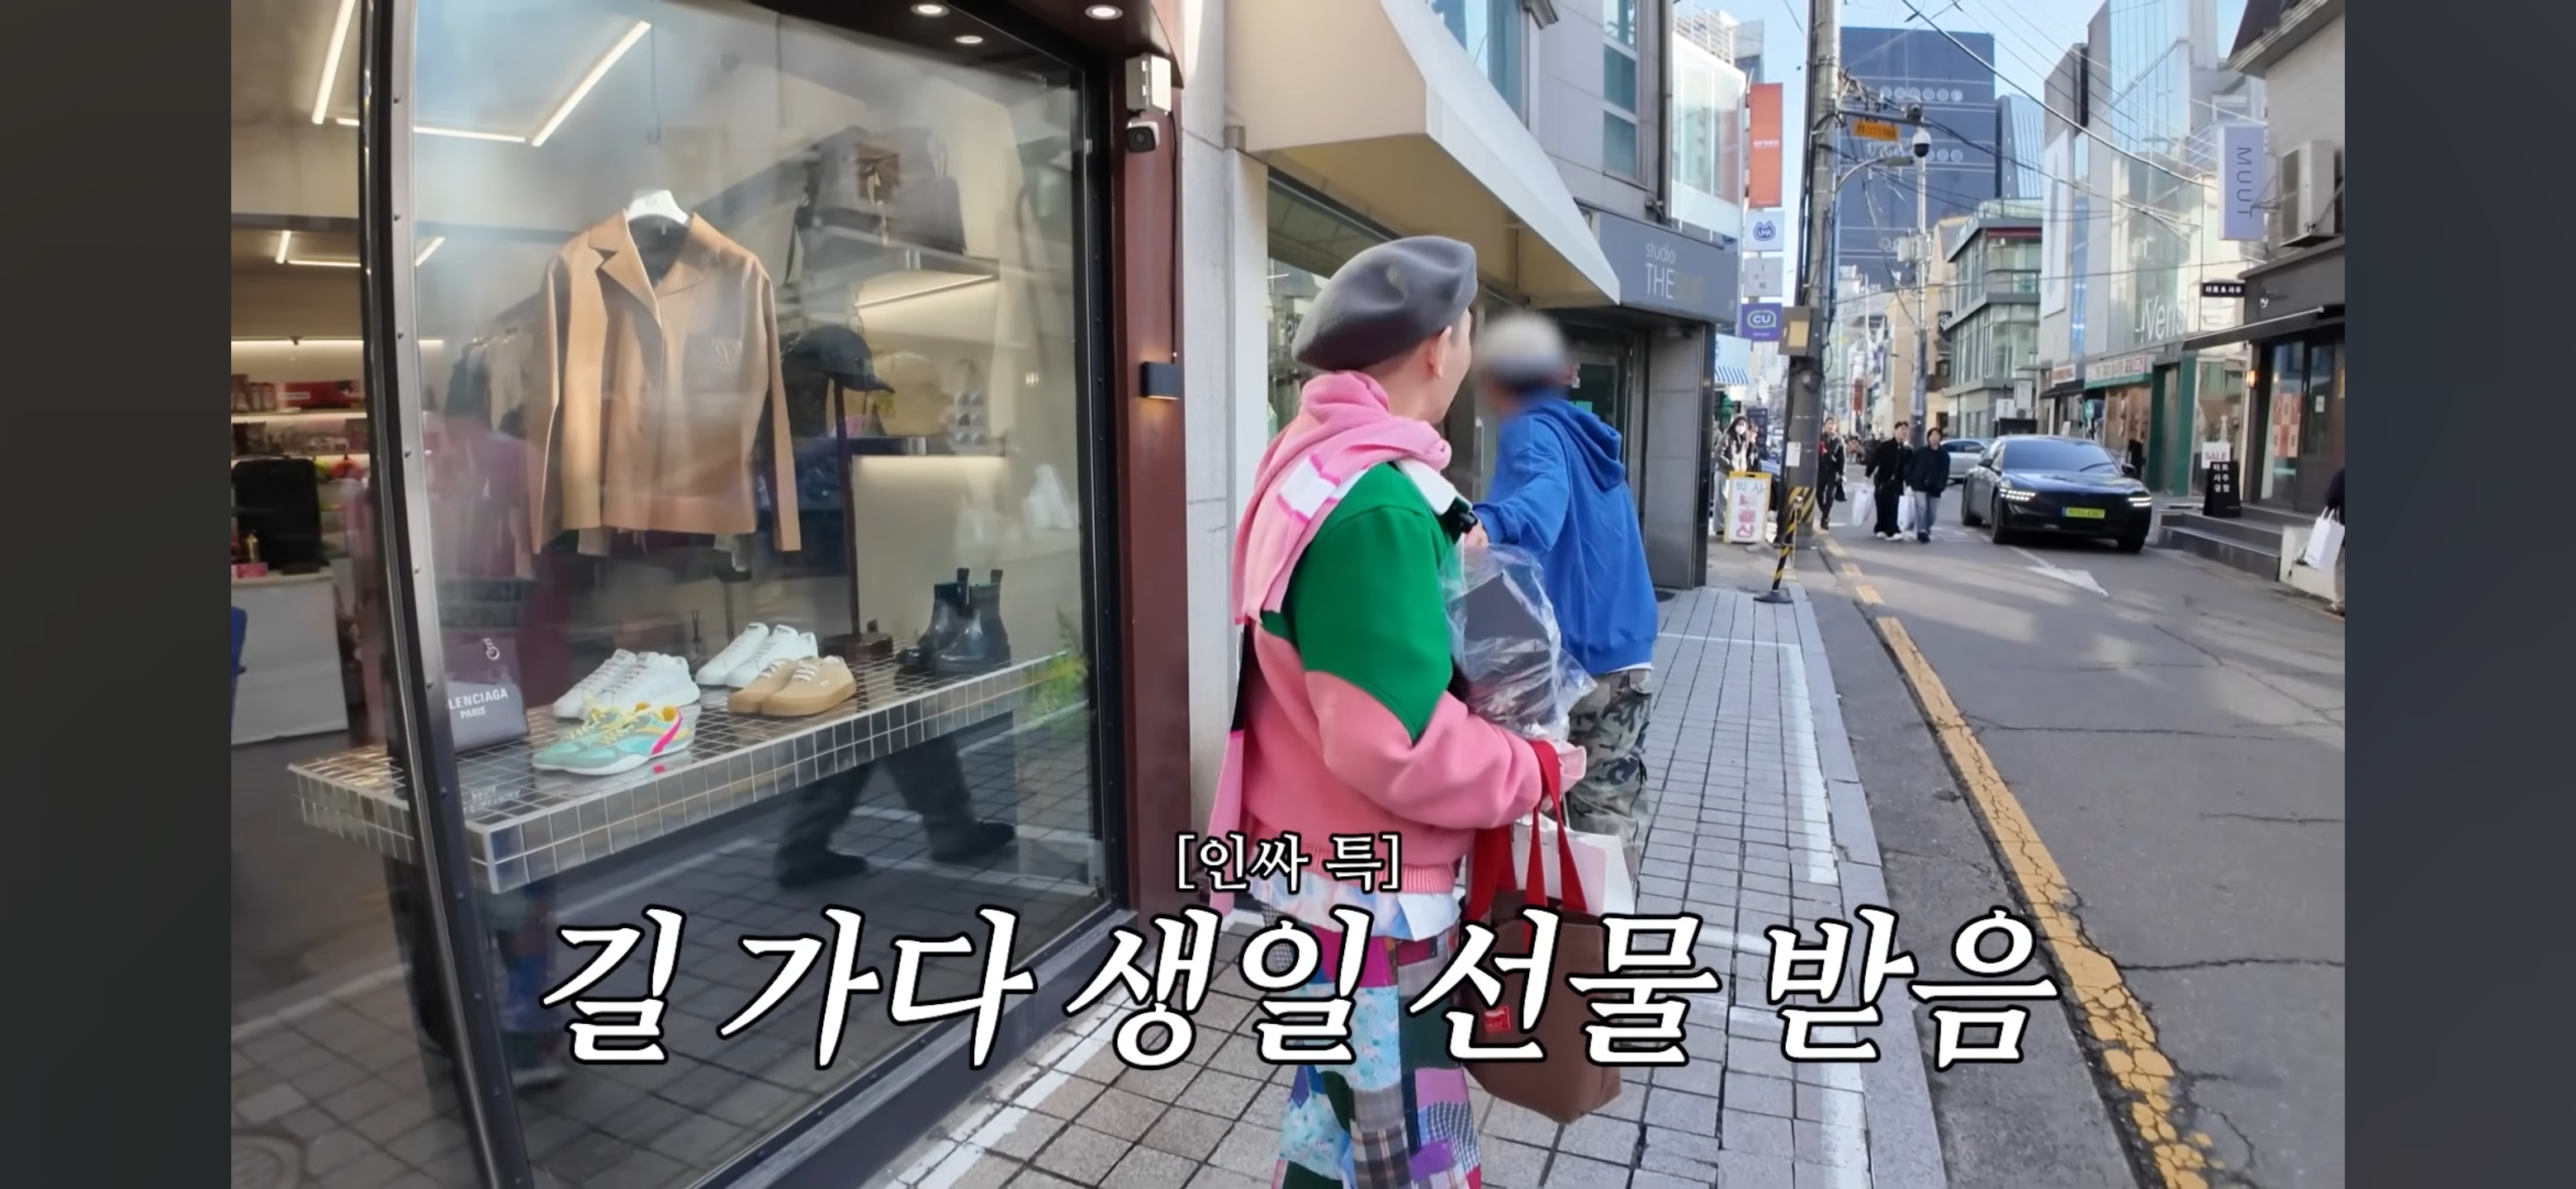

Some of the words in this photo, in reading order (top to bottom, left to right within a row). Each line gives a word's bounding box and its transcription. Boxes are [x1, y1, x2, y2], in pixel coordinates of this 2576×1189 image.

[2237, 147, 2252, 219] MUUT
[1646, 240, 1676, 264] studio
[1646, 263, 1675, 300] THE
[1752, 314, 1771, 324] CU
[2204, 452, 2228, 461] SALE
[460, 706, 486, 720] PARIS
